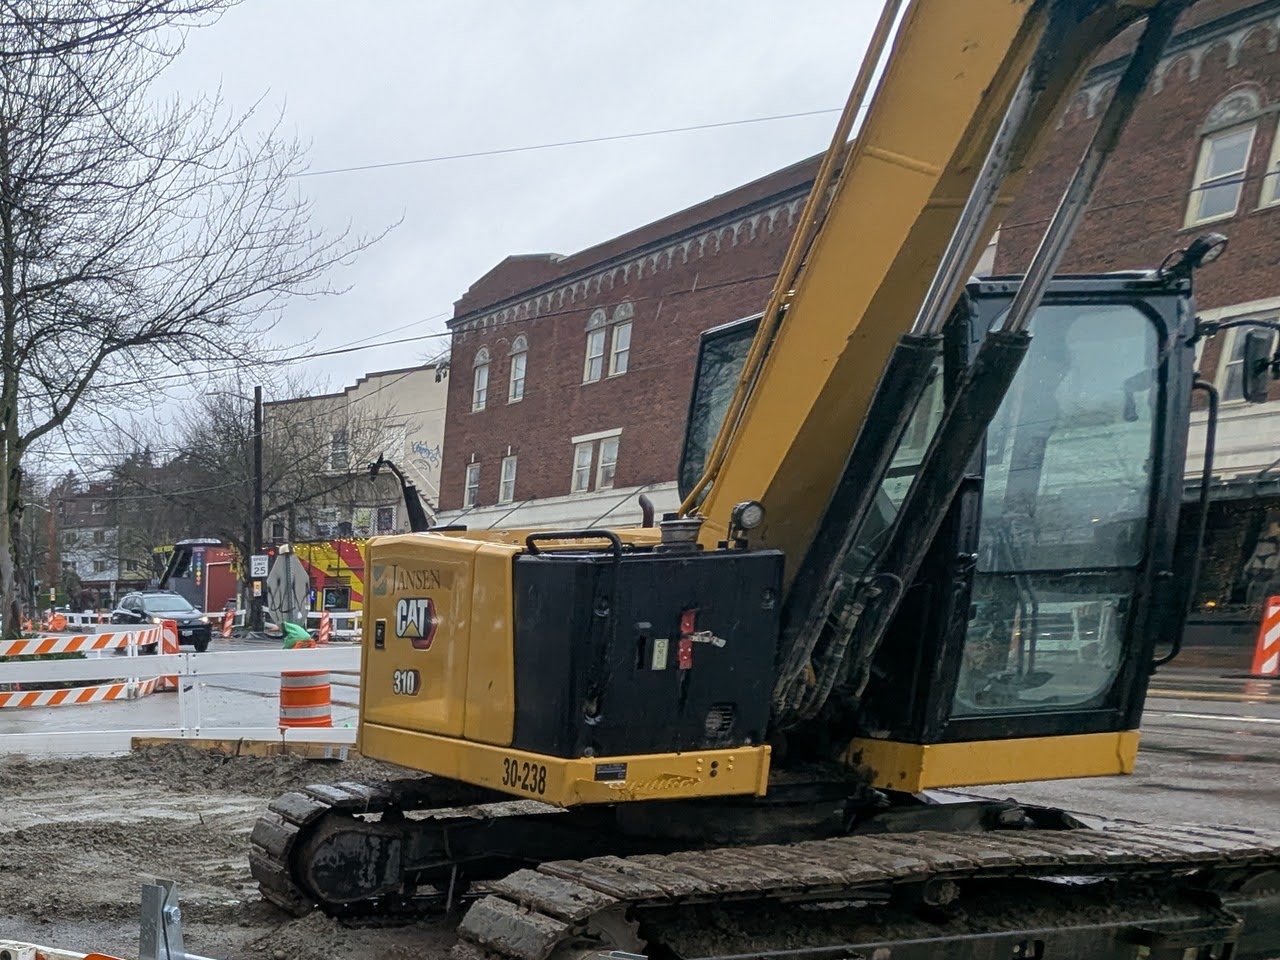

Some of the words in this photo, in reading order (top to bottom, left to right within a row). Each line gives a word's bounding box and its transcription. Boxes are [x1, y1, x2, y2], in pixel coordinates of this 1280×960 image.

[254, 566, 266, 575] 25
[396, 599, 428, 637] CAT
[393, 670, 415, 695] 310
[502, 757, 547, 795] 30-238
